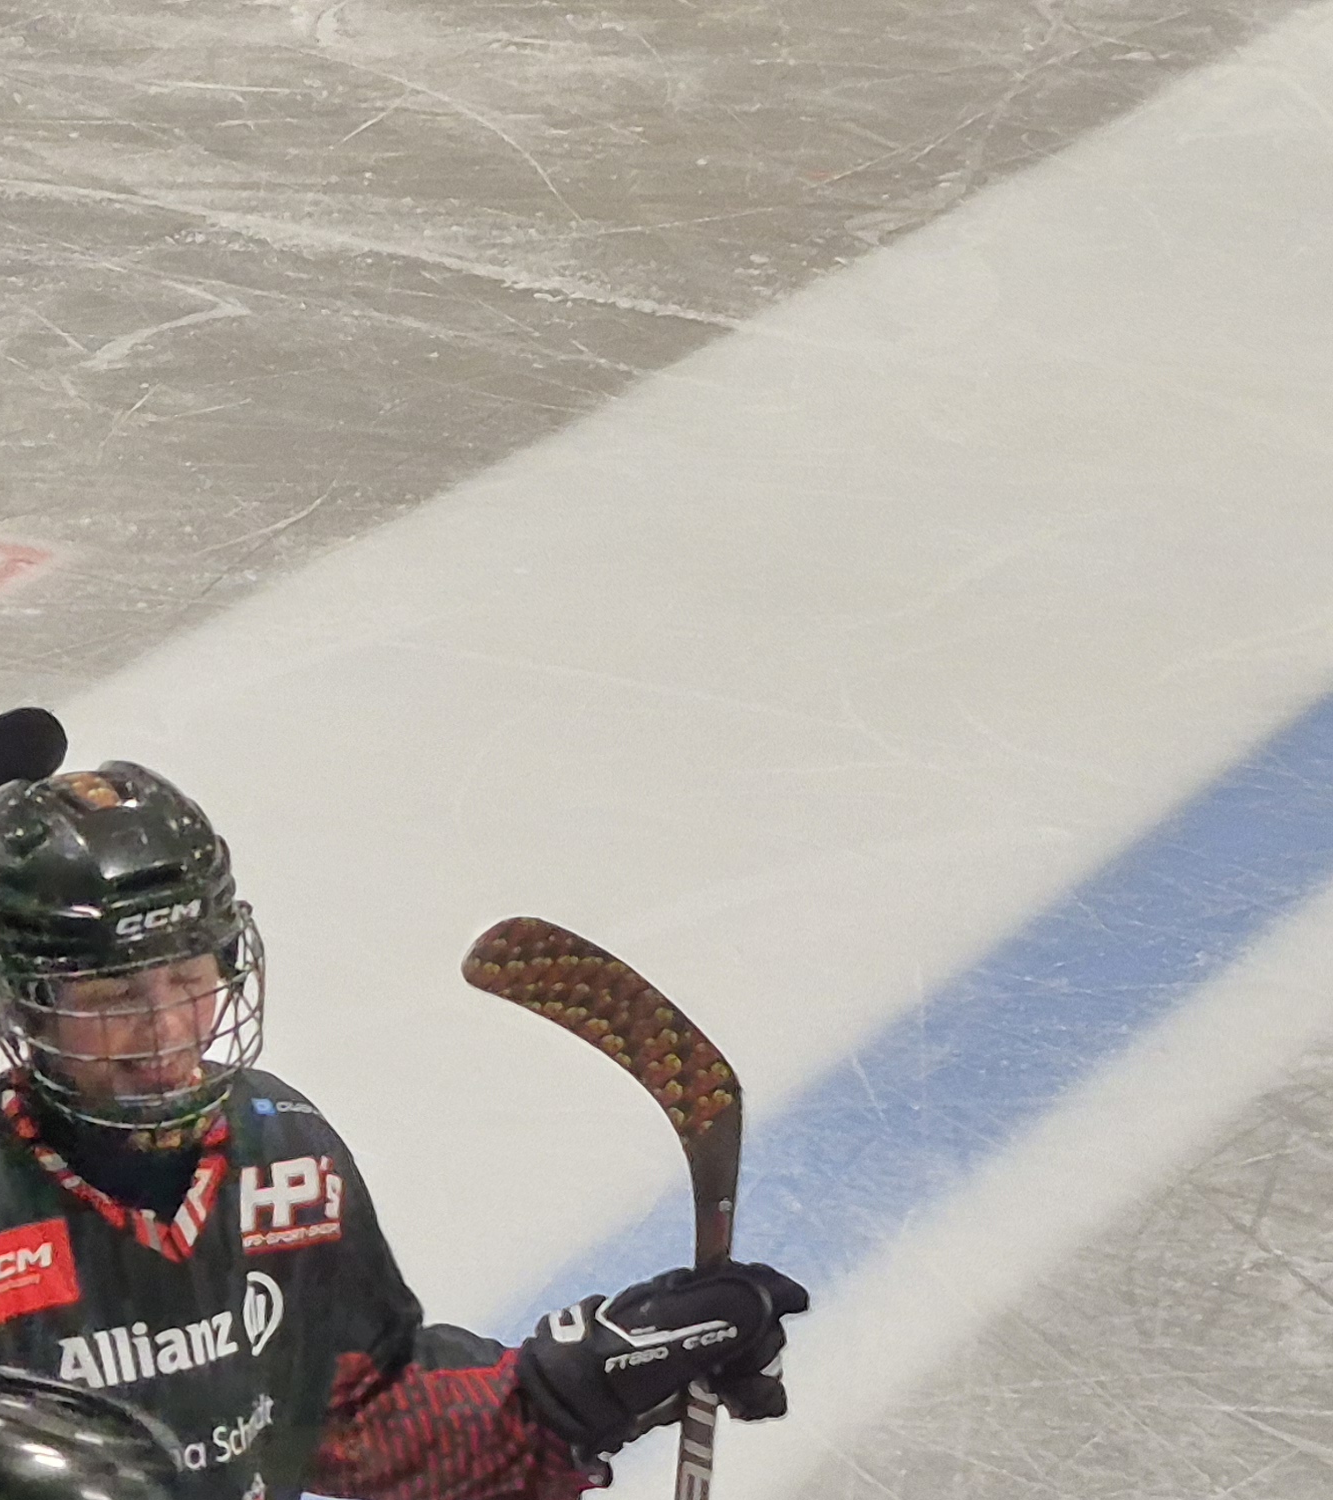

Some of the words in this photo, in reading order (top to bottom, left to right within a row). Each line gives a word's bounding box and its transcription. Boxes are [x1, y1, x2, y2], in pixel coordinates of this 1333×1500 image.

[116, 899, 202, 935] CCM
[58, 1311, 239, 1389] Allianz
[683, 1326, 738, 1350] CCM
